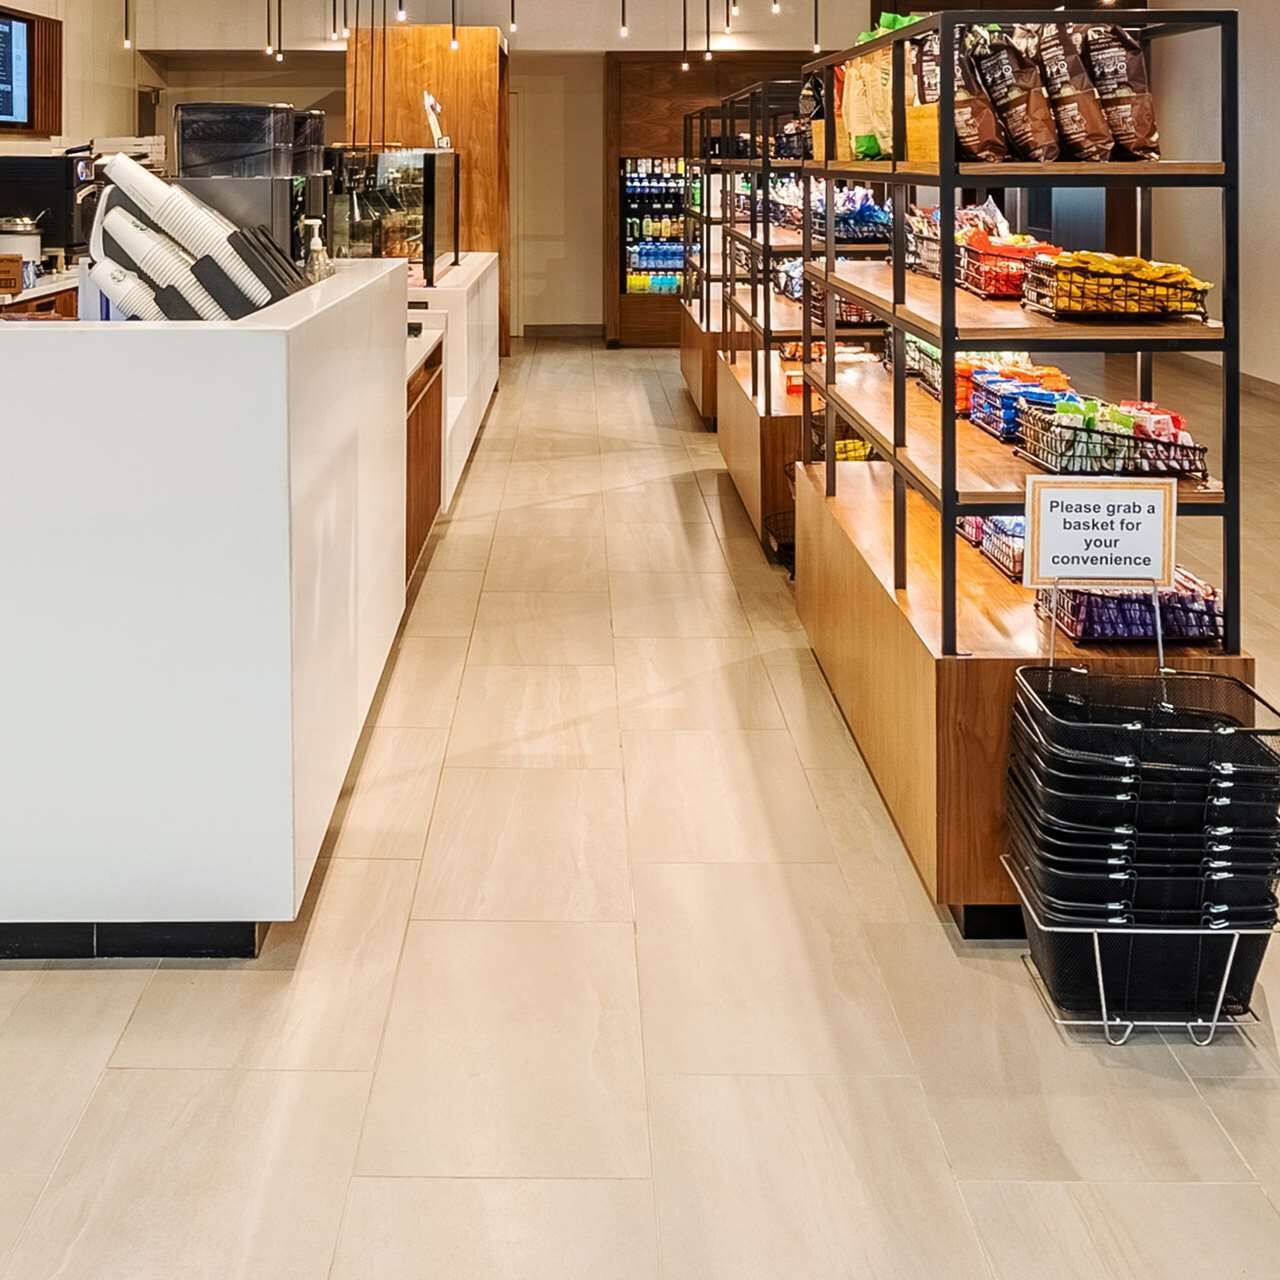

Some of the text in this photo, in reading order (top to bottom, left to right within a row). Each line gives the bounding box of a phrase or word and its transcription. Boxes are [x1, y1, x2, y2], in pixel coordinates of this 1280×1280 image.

[1049, 500, 1156, 517] Please grab a
[1063, 518, 1142, 531] basket for
[1083, 538, 1120, 551] your
[1051, 553, 1152, 566] convenience
